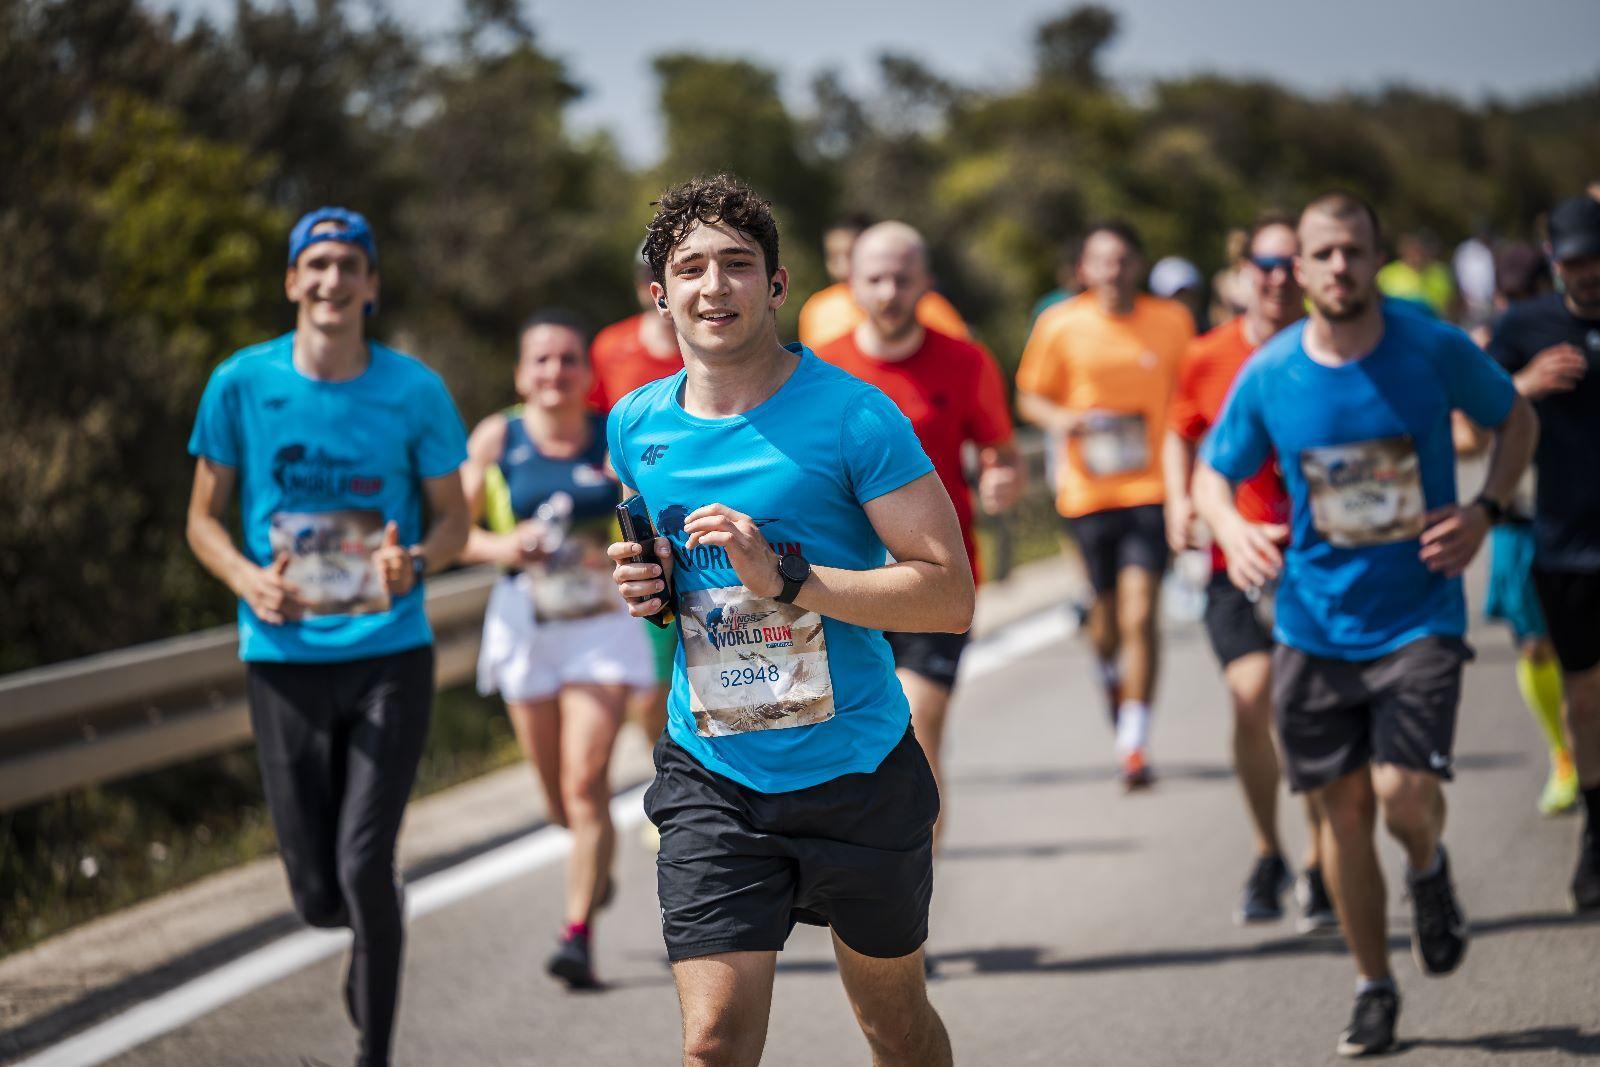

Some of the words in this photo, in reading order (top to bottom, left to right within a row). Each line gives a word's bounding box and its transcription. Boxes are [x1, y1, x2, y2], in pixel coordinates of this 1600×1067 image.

[640, 444, 670, 466] 4F
[716, 628, 763, 651] WORLD
[762, 624, 794, 643] RUN
[720, 664, 780, 688] 52948
